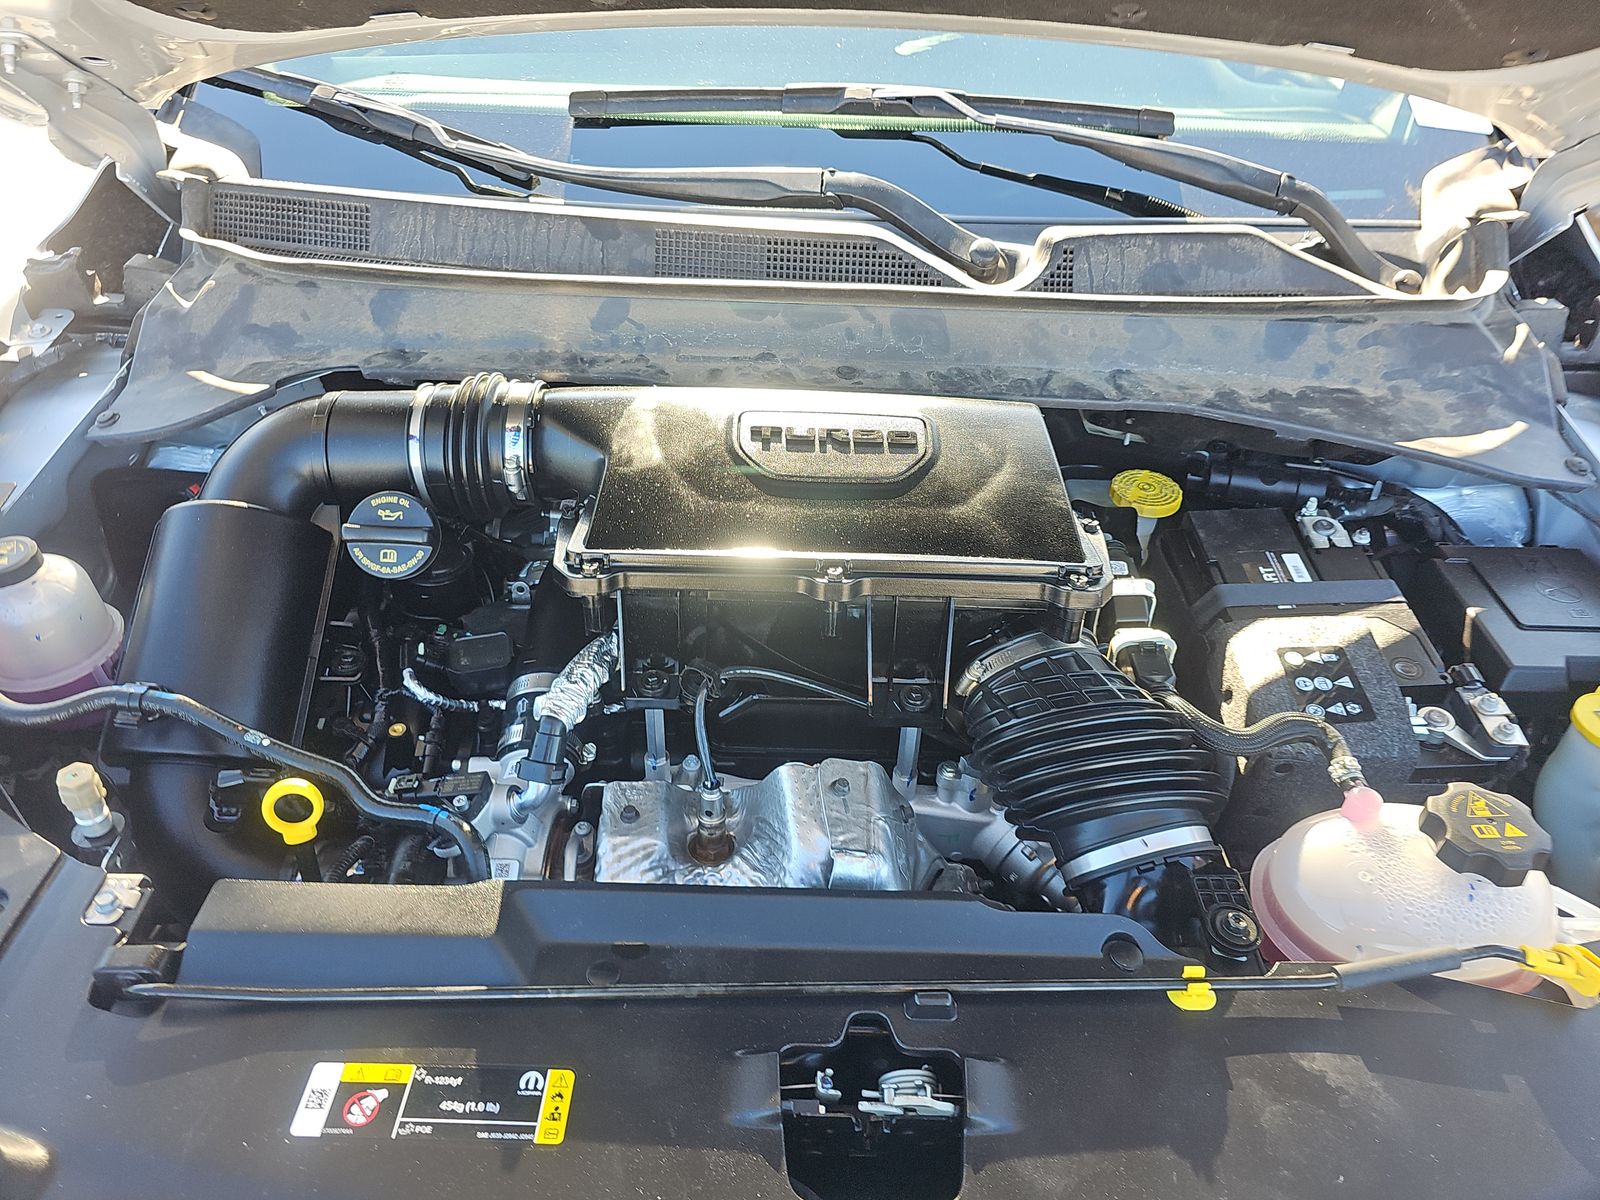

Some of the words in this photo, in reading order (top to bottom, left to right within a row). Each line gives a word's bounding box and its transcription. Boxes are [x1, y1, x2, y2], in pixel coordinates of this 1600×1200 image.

[750, 426, 919, 454] TURBO
[370, 496, 398, 507] ENGINE
[399, 497, 411, 508] OIL
[415, 1125, 433, 1134] POE
